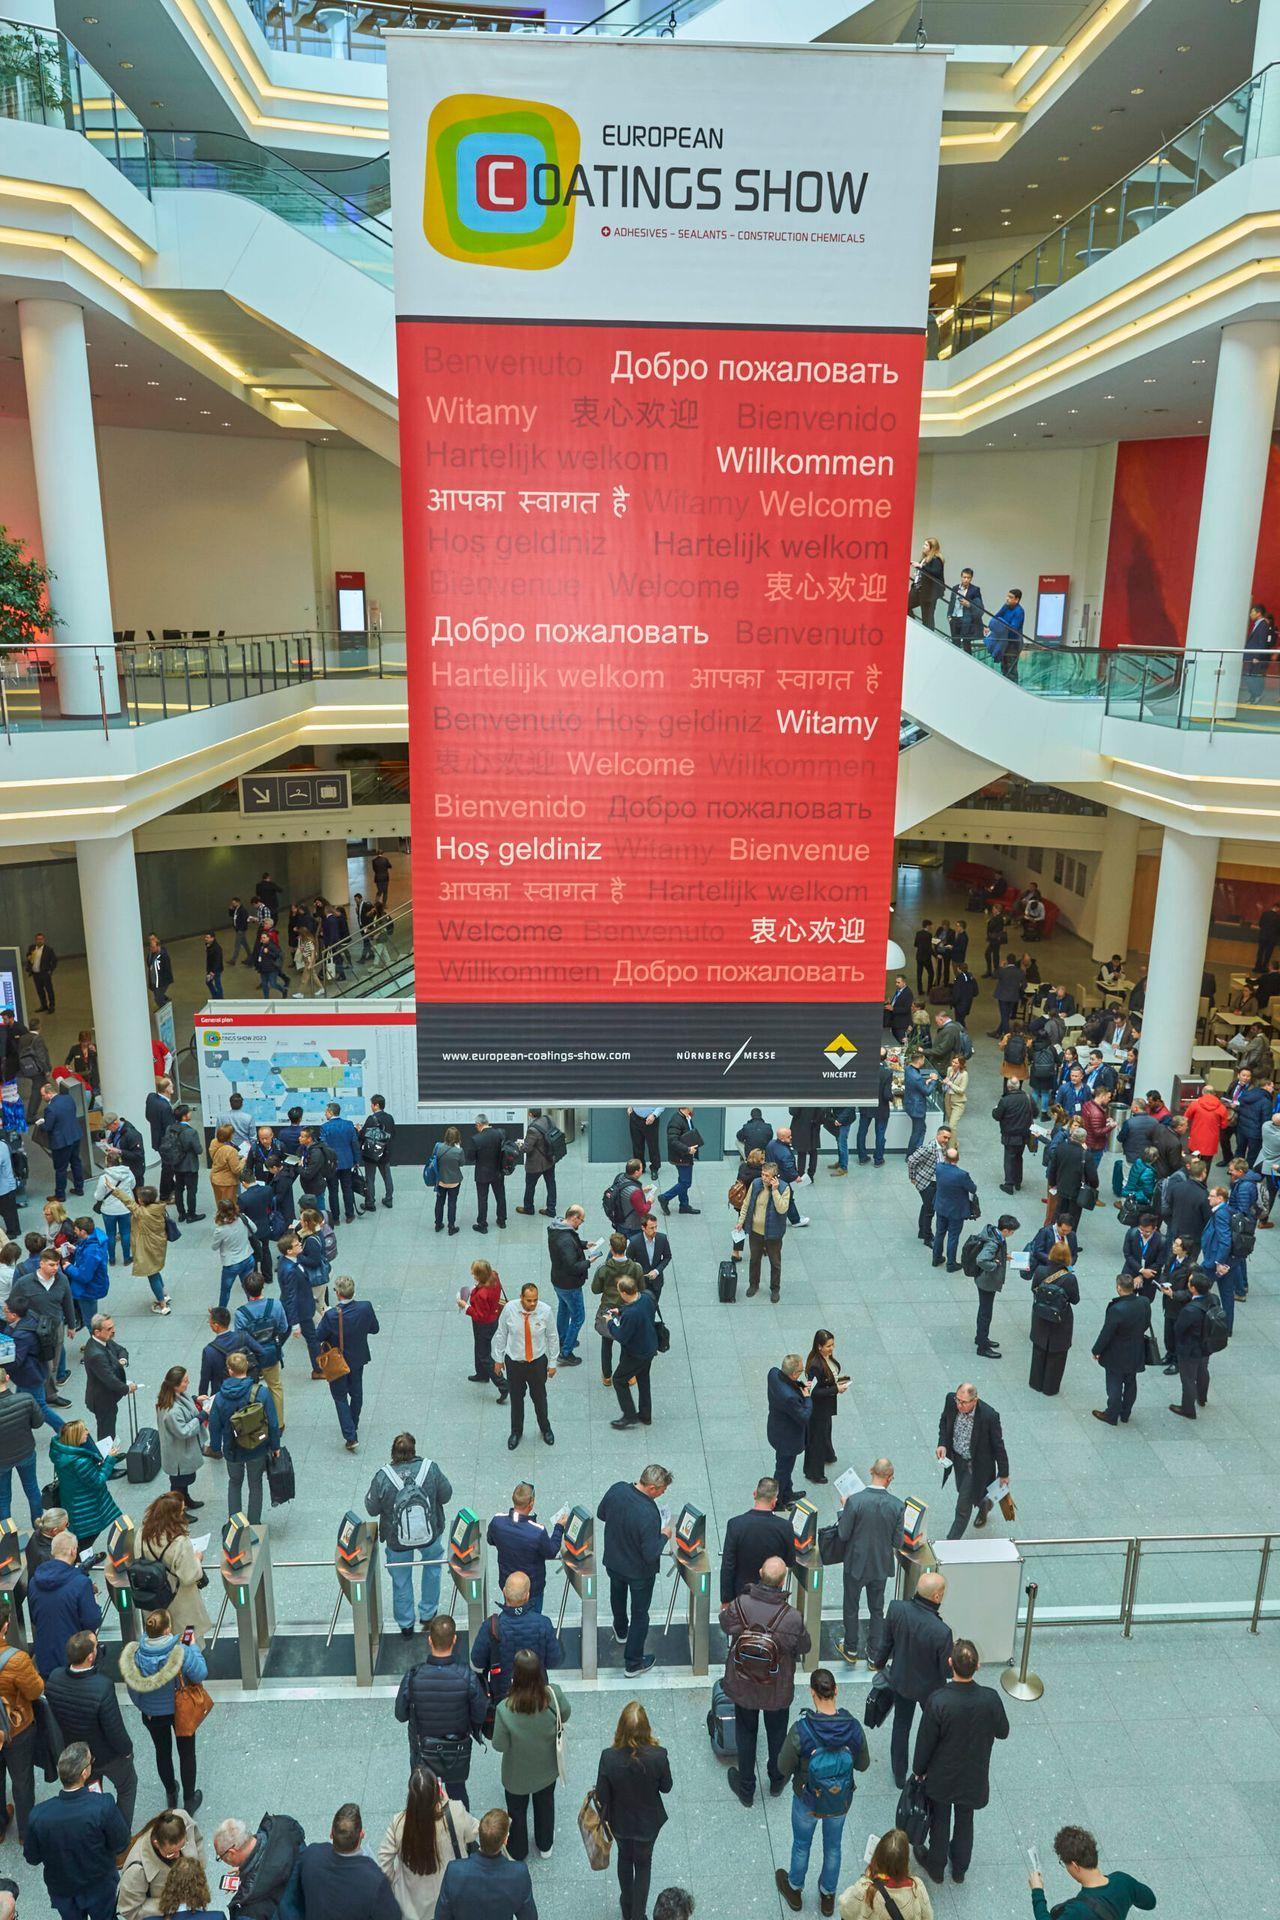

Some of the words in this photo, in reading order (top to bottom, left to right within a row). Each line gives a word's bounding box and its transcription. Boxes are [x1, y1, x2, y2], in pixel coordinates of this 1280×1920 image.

[602, 125, 724, 150] EUROPEAN
[487, 161, 721, 210] COATINGS
[734, 169, 870, 214] SHOW
[614, 227, 668, 238] ADHESIVES
[678, 229, 726, 240] SEALANTS
[737, 231, 808, 242] CONSTRUCTION
[810, 232, 865, 243] CHEMICALS
[424, 347, 582, 376] Benvenuto
[610, 350, 708, 386] Добро
[719, 359, 899, 384] пожаловать
[426, 397, 537, 432] Witamy
[570, 398, 699, 430] 衷心欢迎
[738, 403, 896, 432] Bienvenido
[427, 442, 546, 475] Hartelijk
[558, 445, 668, 471] welkom
[716, 446, 894, 477] Willkommen
[427, 488, 505, 512] आपका
[519, 492, 599, 514] स्वागत
[613, 485, 630, 519] है
[641, 488, 749, 522] Witamy
[759, 490, 892, 519] Welcome
[496, 529, 607, 560] geldiniz
[654, 532, 770, 564] Hartelijk
[781, 534, 888, 560] welkom
[431, 571, 579, 596] Bienvenue
[608, 572, 739, 599] Welcome
[764, 572, 888, 602] 衷心欢迎
[432, 616, 525, 648] Добро
[535, 622, 710, 645] пожаловать
[736, 620, 883, 646] Benvenuto
[432, 663, 547, 693] Hartelijk
[557, 665, 664, 688] welkom
[690, 668, 764, 689] आपका
[777, 670, 853, 691] स्वागत
[866, 664, 882, 693] है
[433, 707, 581, 731] Benvenuto
[596, 708, 648, 738] Hoş
[659, 707, 762, 739] geldiniz
[776, 708, 879, 741] Witamy
[434, 748, 554, 776] 衷心欢迎
[567, 752, 695, 776] Welcome
[710, 752, 875, 777] Willkommen
[434, 794, 586, 818] Bienvenido
[608, 795, 696, 823] Добро
[707, 801, 872, 820] пожаловать
[436, 837, 489, 866] Hoş
[499, 837, 602, 866] geldiniz
[615, 838, 714, 865] Witamy
[729, 838, 870, 861] Bienvenue
[438, 882, 511, 901] आपका
[524, 882, 598, 902] स्वागत
[610, 877, 626, 904] है
[649, 880, 757, 907] Hartelijk
[767, 882, 868, 901] welkom
[438, 920, 563, 942] Welcome
[584, 921, 724, 943] Benvenuto
[749, 917, 866, 945] 衷心欢迎
[438, 960, 599, 982] Willkommen
[614, 960, 698, 986] Добро
[707, 965, 864, 982] пожаловать
[222, 1017, 234, 1025] plan
[442, 1052, 631, 1062] www.european-coatings-show.com
[676, 1051, 731, 1060] NÜRNBERG
[744, 1052, 776, 1060] MESSE
